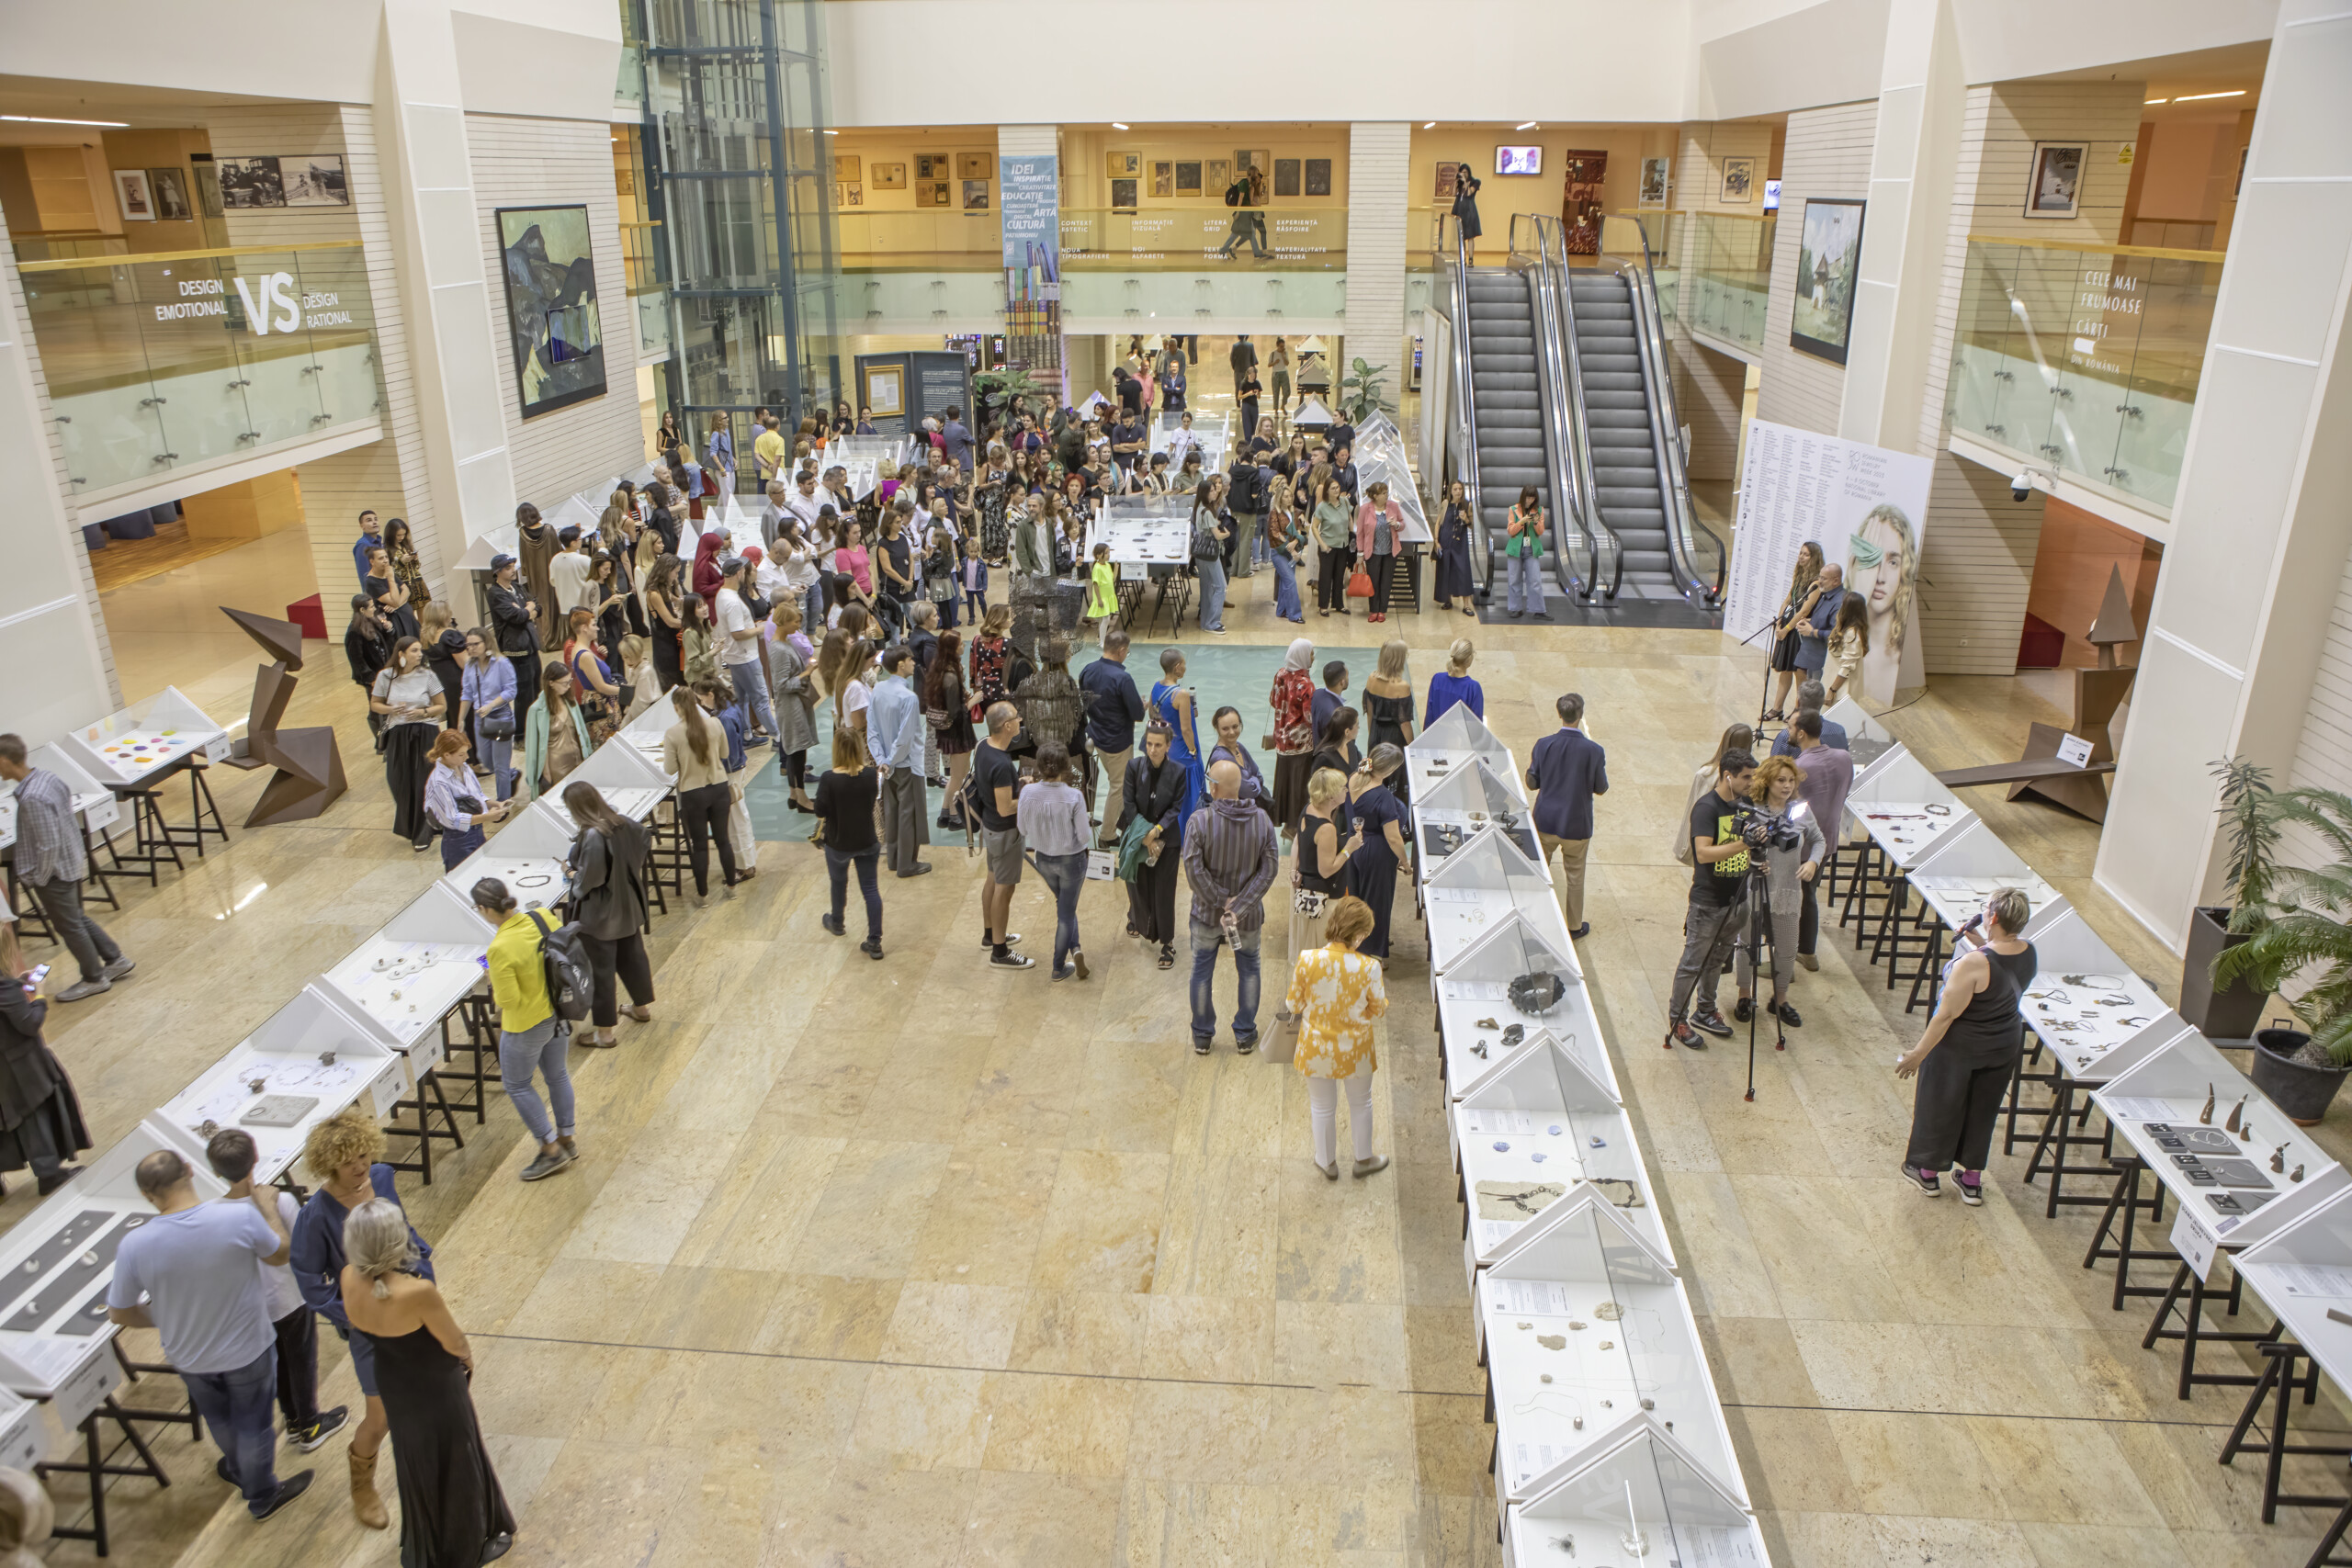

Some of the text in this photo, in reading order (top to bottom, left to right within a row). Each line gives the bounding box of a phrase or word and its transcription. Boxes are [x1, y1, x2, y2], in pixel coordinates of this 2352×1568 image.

[1012, 164, 1034, 175] IDEI
[1034, 207, 1057, 217] ARTĂ
[1007, 219, 1046, 230] CULTURĂ
[178, 278, 224, 297] DESIGN
[2085, 270, 2138, 292] CELE MAI
[155, 300, 229, 321] EMOTIONAL
[232, 272, 300, 336] VS
[302, 292, 339, 310] DESIGN
[2081, 292, 2142, 315] FRUMOASE
[306, 310, 353, 329] RATIONAL
[2070, 354, 2084, 366] DIN
